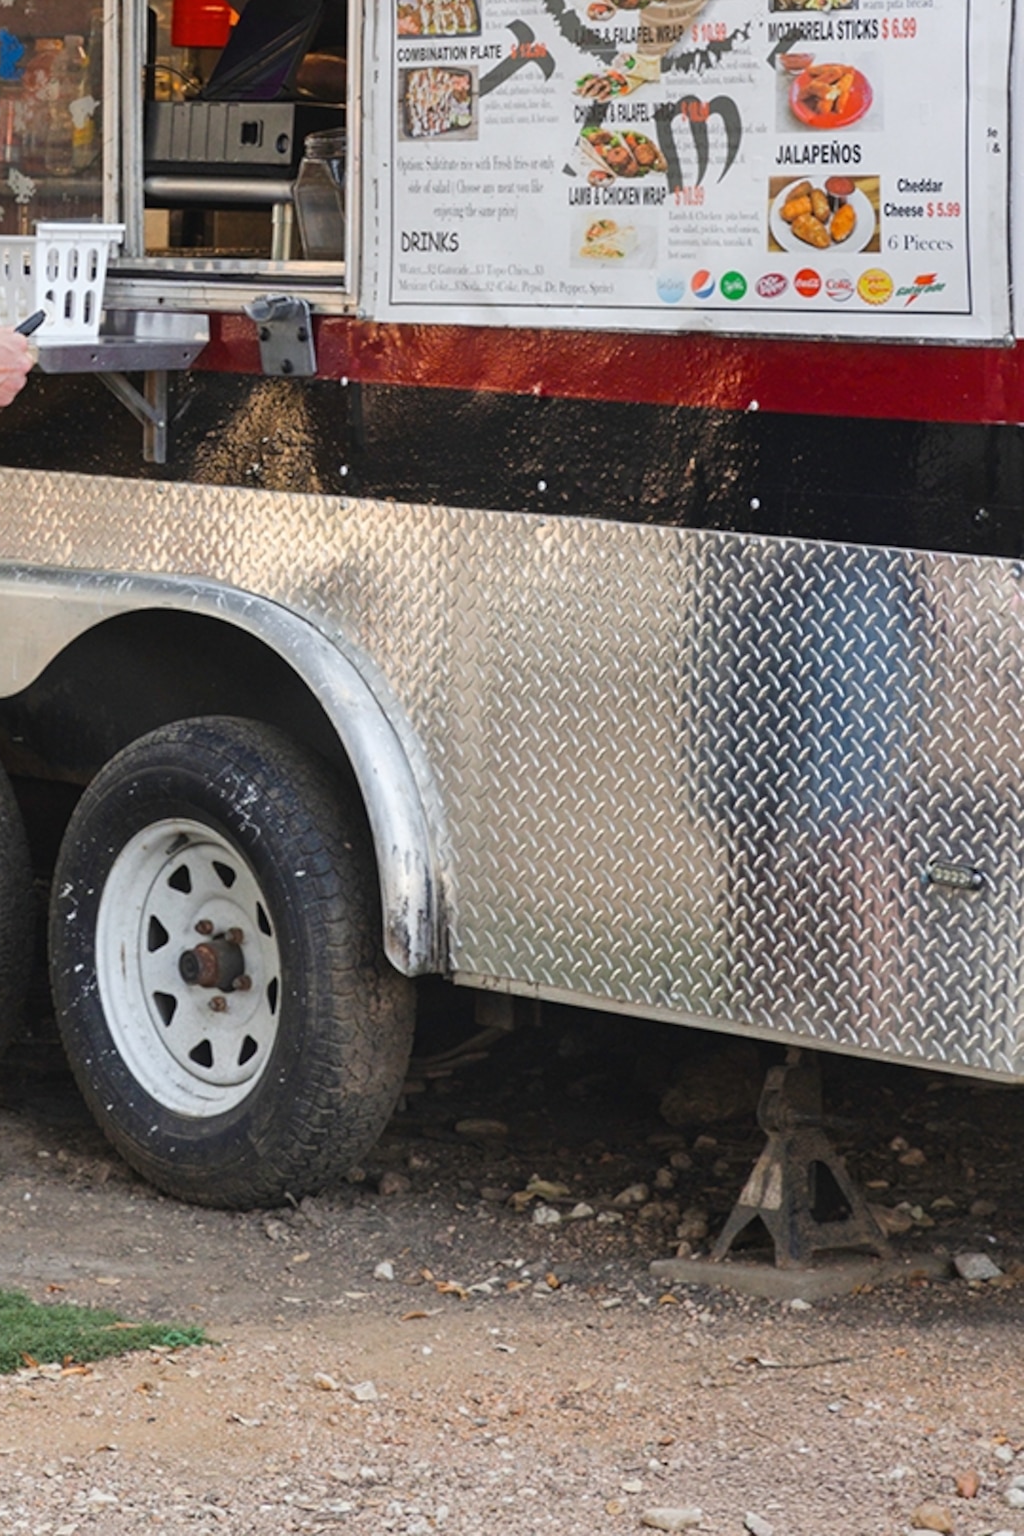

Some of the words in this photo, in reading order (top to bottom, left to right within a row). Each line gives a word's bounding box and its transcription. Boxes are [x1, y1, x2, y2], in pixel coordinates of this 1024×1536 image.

[614, 26, 654, 44] FALAFEL
[656, 24, 684, 42] WRAP
[837, 18, 878, 41] STICKS
[881, 18, 888, 39] $
[892, 17, 917, 39] 6.99
[396, 46, 468, 63] COMBINATION
[470, 44, 502, 61] PLATE
[617, 103, 649, 123] FALAFEL
[775, 140, 862, 165] JALAPEÑOS
[569, 186, 592, 206] LAMB
[603, 186, 640, 206] CHICKEN
[642, 185, 666, 205] WRAP
[897, 178, 943, 194] Cheddar
[884, 202, 924, 218] Cheese
[927, 202, 934, 218] $
[936, 202, 961, 218] 5.99
[401, 231, 459, 253] DRINKS
[888, 234, 898, 251] 6
[903, 234, 954, 252] Pieces
